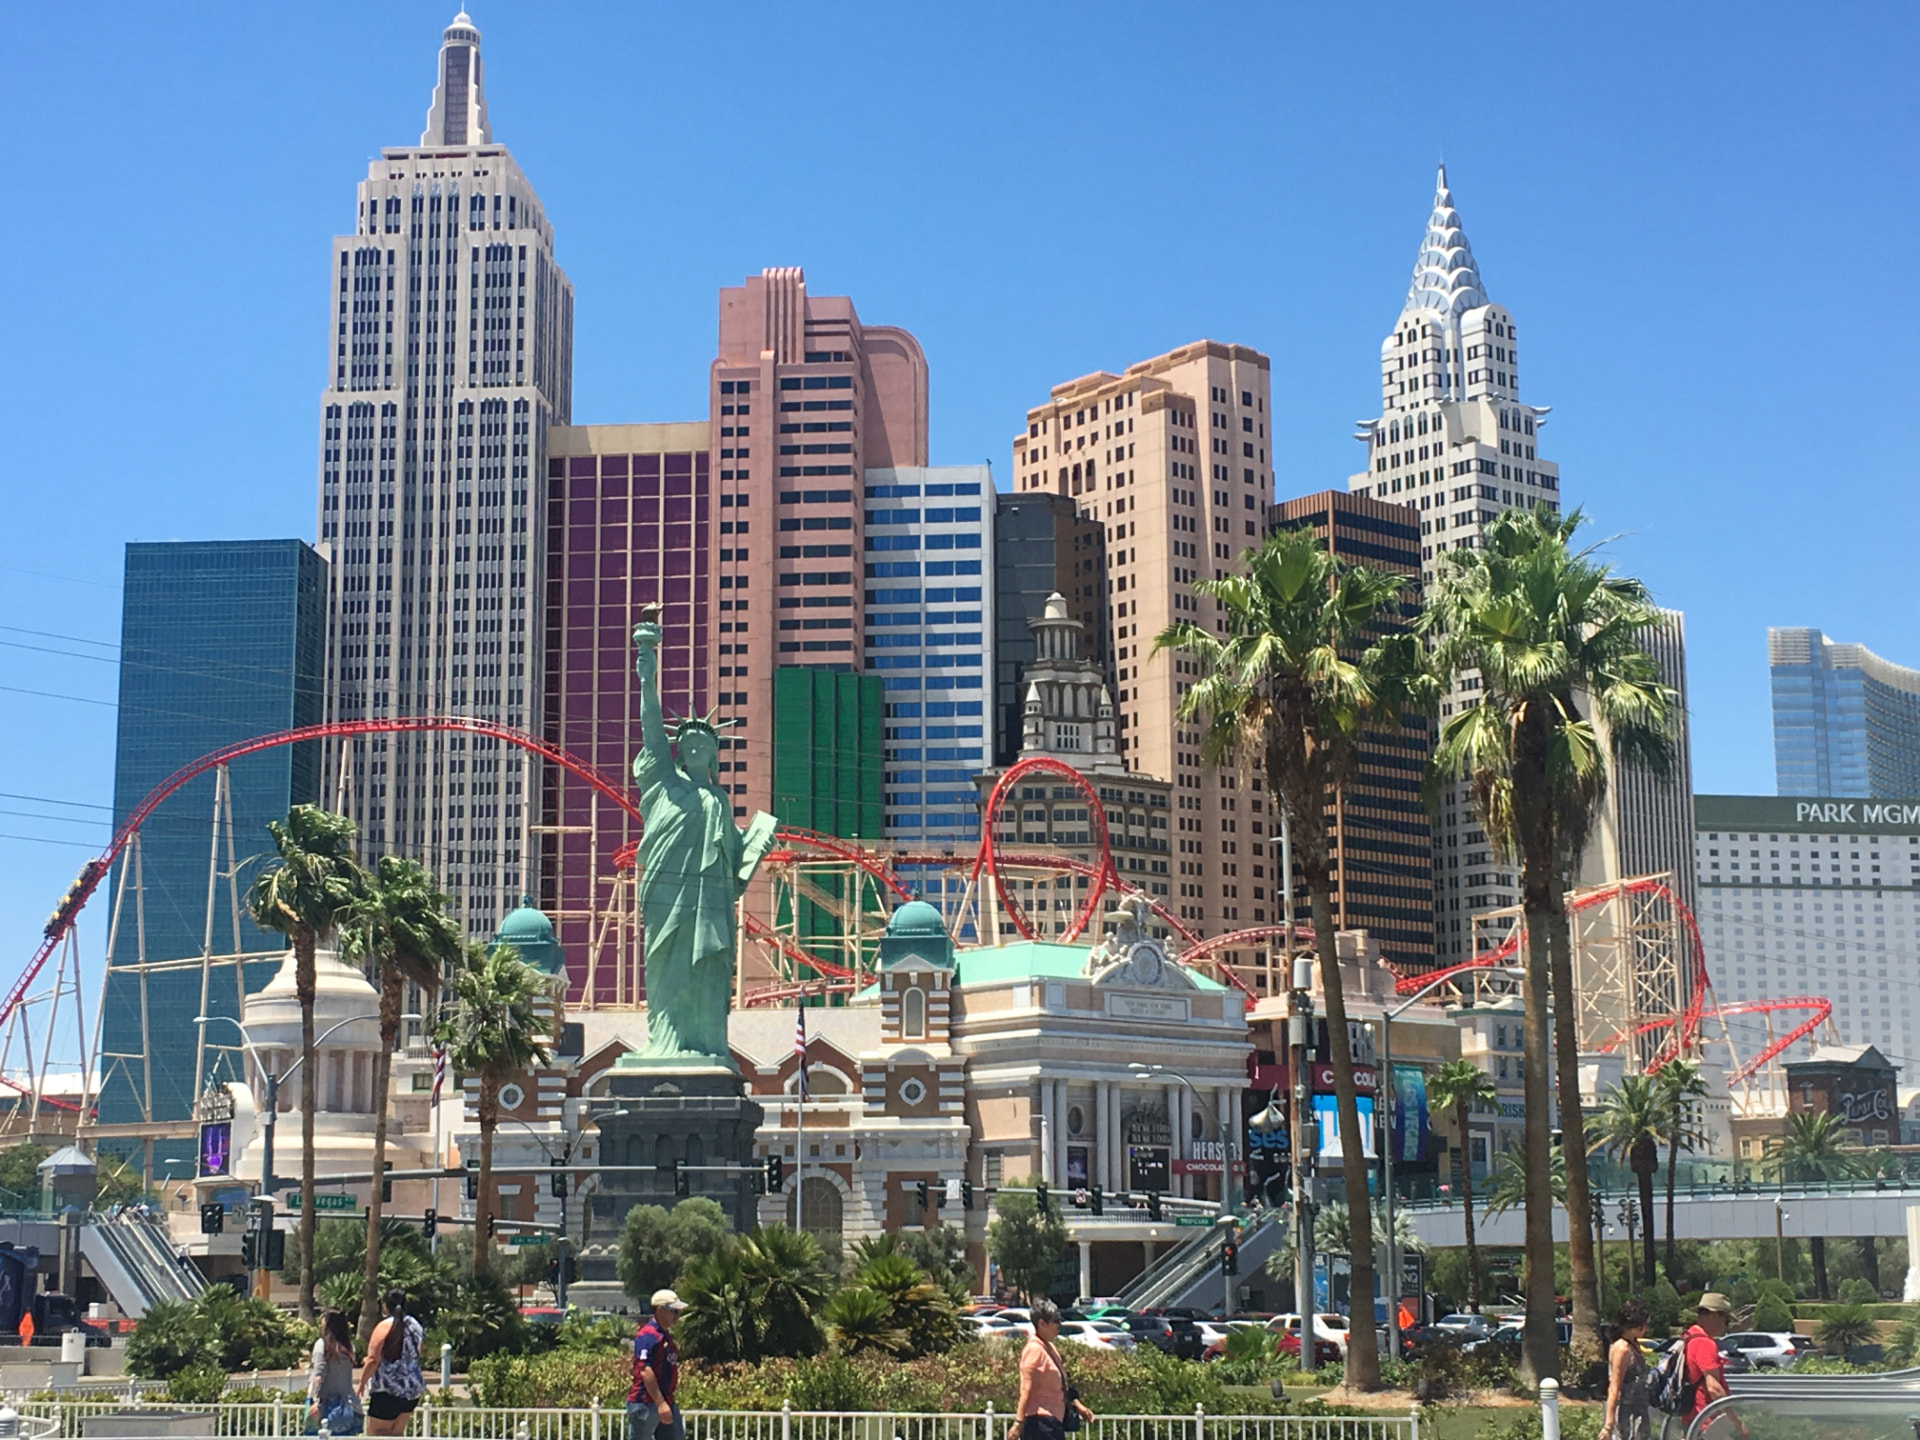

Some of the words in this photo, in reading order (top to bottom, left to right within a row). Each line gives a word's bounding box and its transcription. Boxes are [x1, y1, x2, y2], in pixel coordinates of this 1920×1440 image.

[1796, 803, 1857, 823] PARK
[1863, 804, 1920, 824] MGM
[315, 1195, 343, 1207] Vegas
